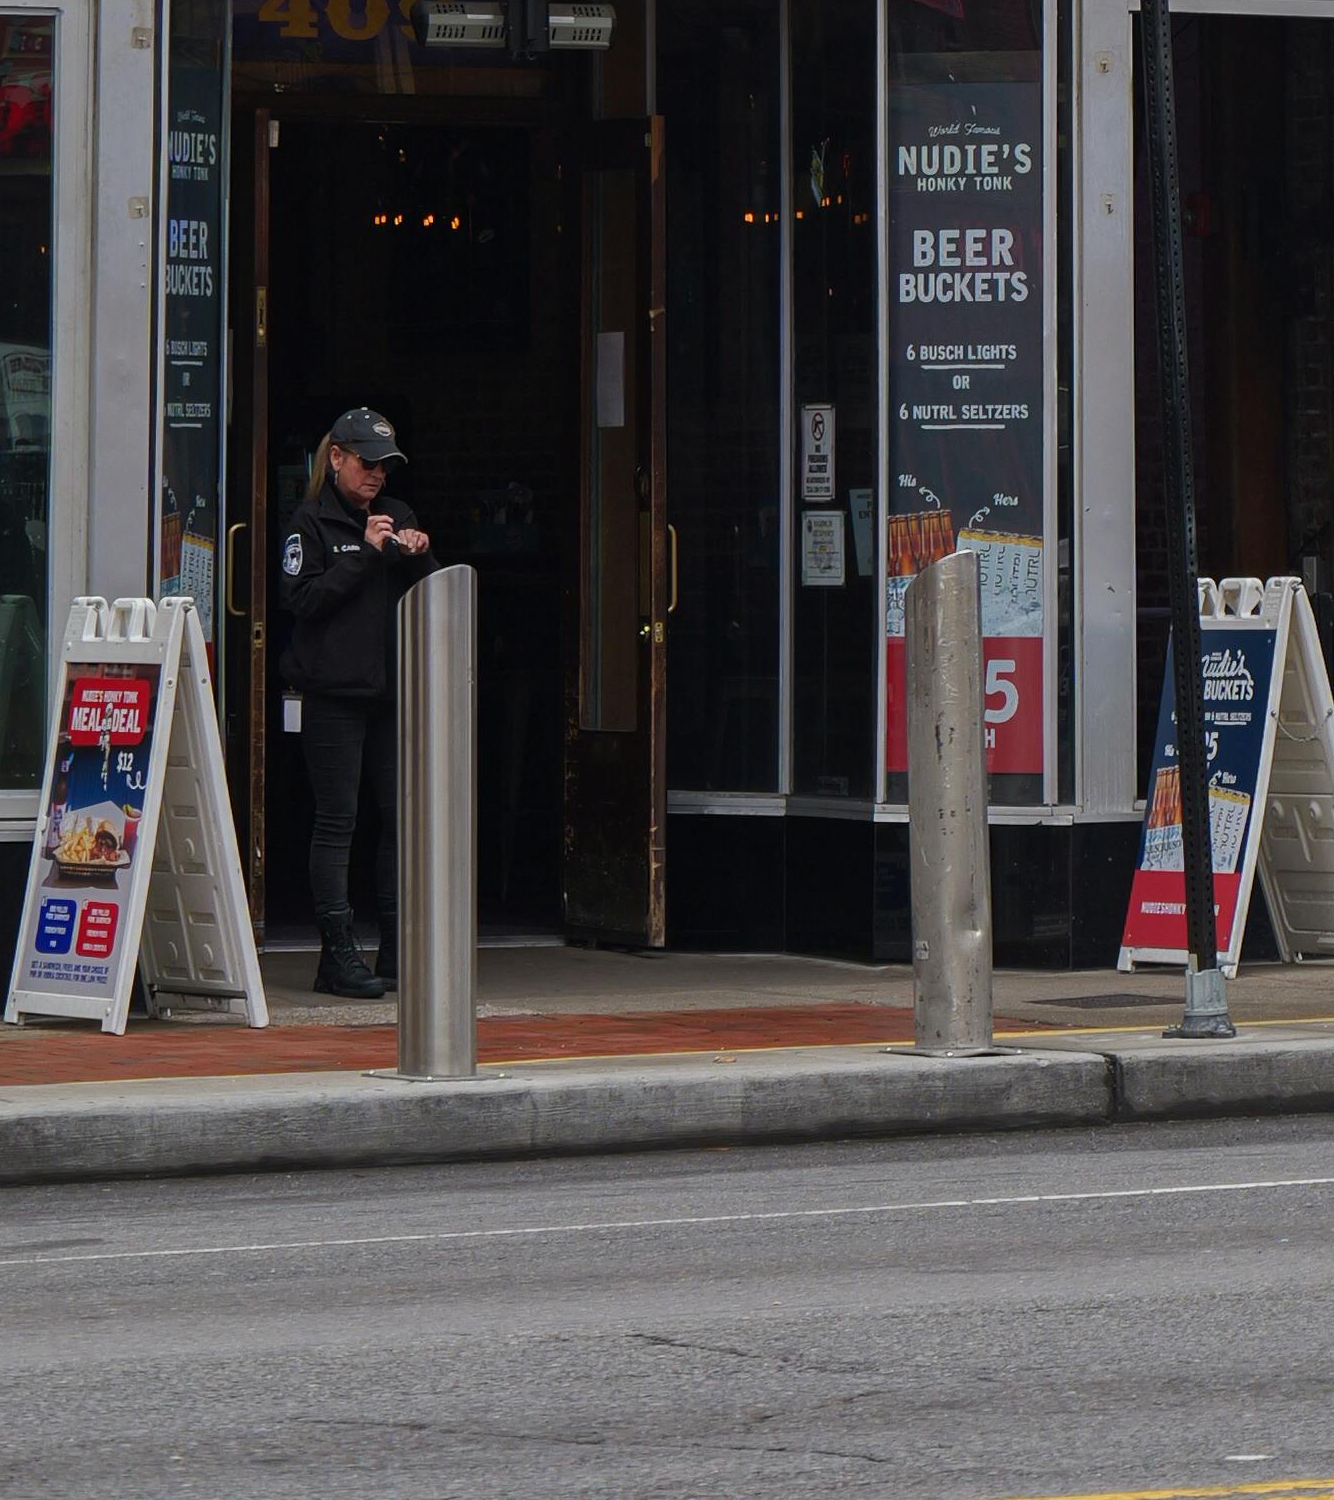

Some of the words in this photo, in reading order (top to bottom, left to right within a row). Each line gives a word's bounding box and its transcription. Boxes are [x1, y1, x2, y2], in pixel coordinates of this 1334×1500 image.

[898, 142, 1033, 176] NUDIE'S
[917, 176, 967, 192] HONKY
[973, 176, 1013, 191] TONK
[169, 219, 208, 260] BEER
[912, 228, 1015, 268] BEER
[898, 272, 1029, 303] BUCKETS
[906, 344, 916, 361] 6
[919, 344, 964, 361] BUSCH
[967, 344, 1017, 361] LIGHTS
[952, 374, 970, 390] OR
[899, 403, 909, 421] 6
[912, 404, 958, 421] NUTRL
[961, 403, 1029, 421] SELTZERS
[898, 474, 917, 488] His
[993, 492, 1019, 507] Hers
[1203, 679, 1255, 701] BUCKETS
[70, 706, 102, 732] MEAL
[111, 708, 141, 734] DEAL
[115, 750, 134, 774] $12
